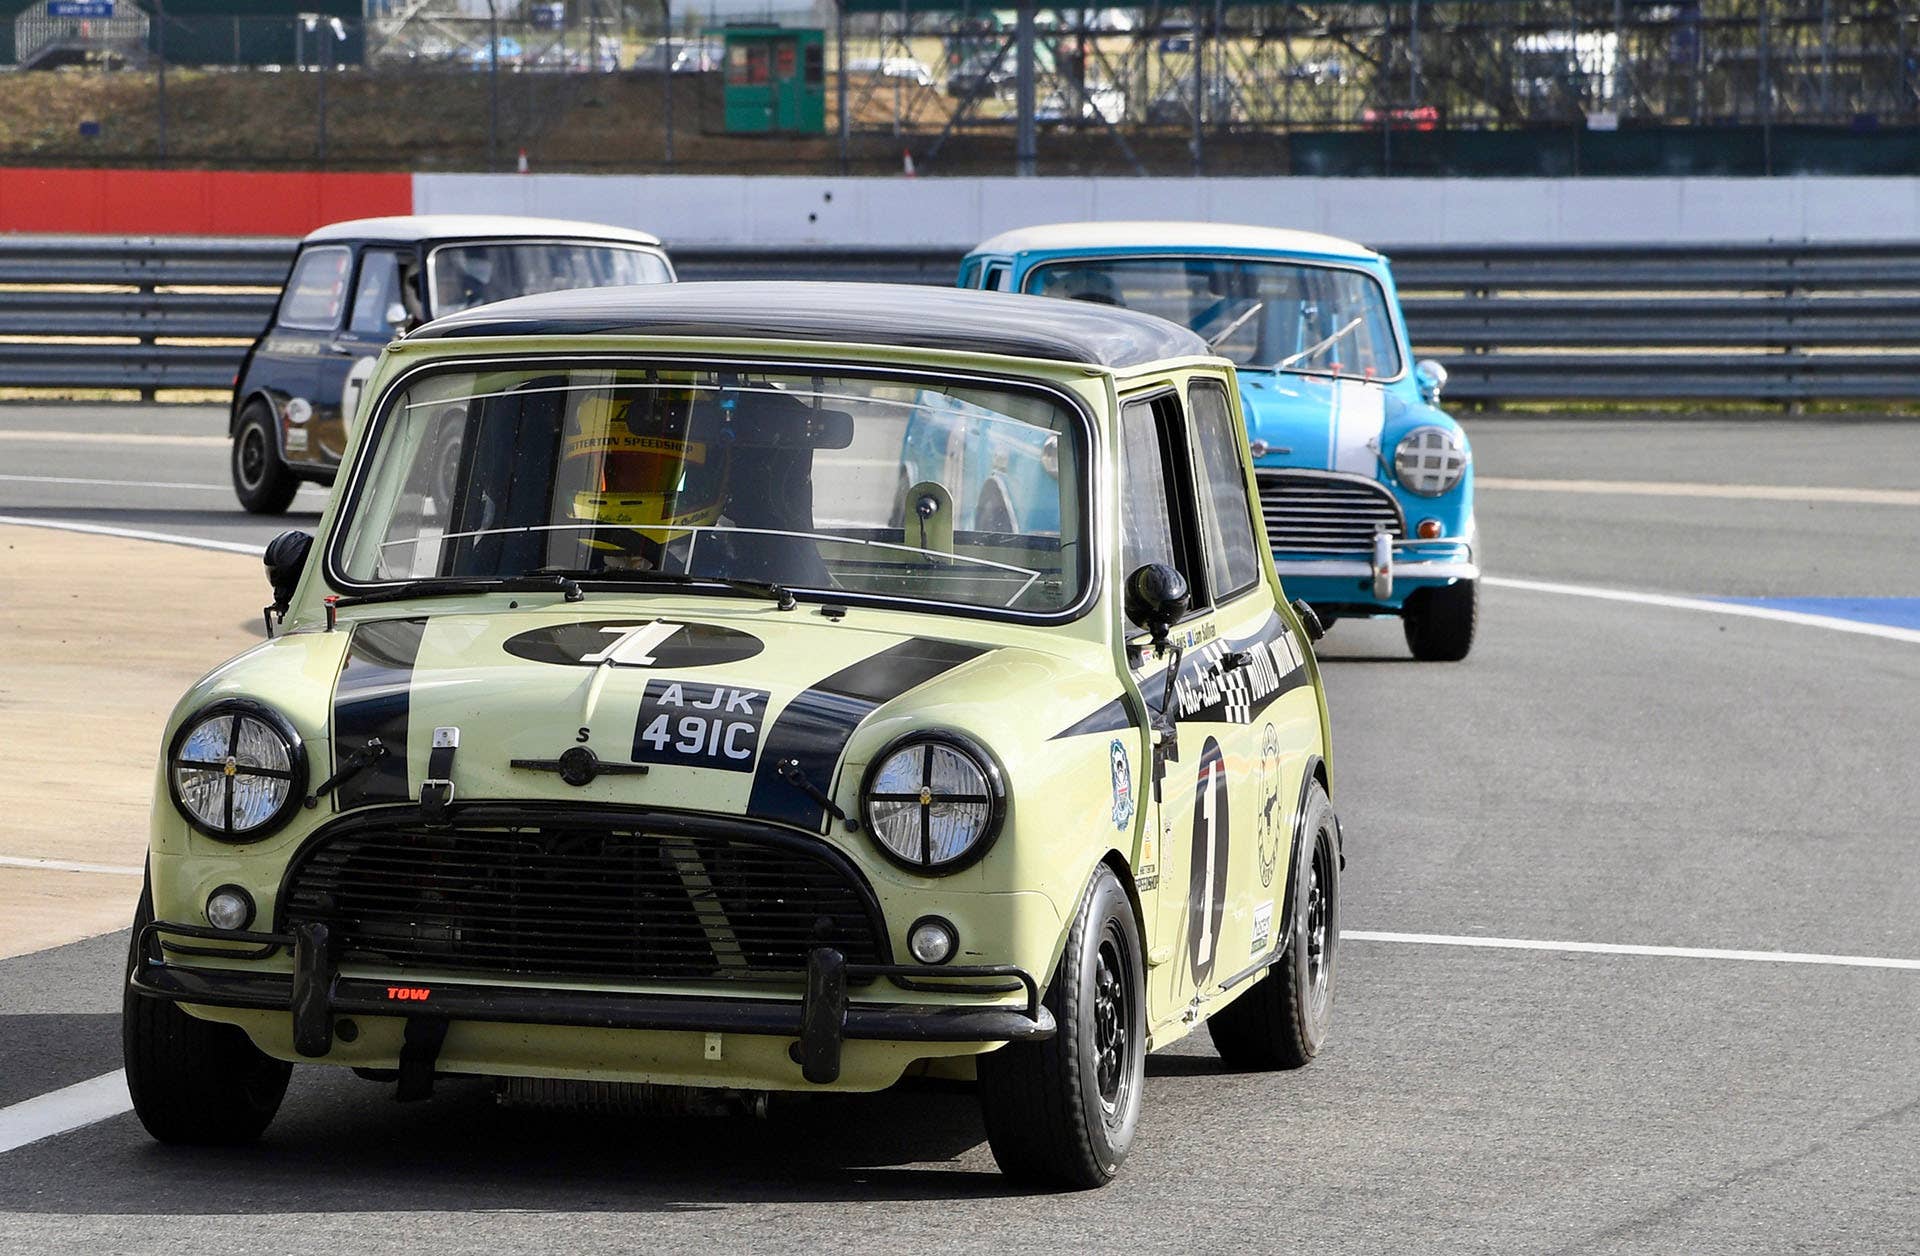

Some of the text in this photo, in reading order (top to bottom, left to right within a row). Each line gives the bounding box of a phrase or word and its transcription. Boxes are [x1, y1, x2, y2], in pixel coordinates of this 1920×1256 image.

[580, 624, 684, 665] 1
[657, 683, 759, 715] AJK
[576, 727, 590, 743] S
[1197, 759, 1218, 966] 1
[387, 987, 430, 1001] TOW
